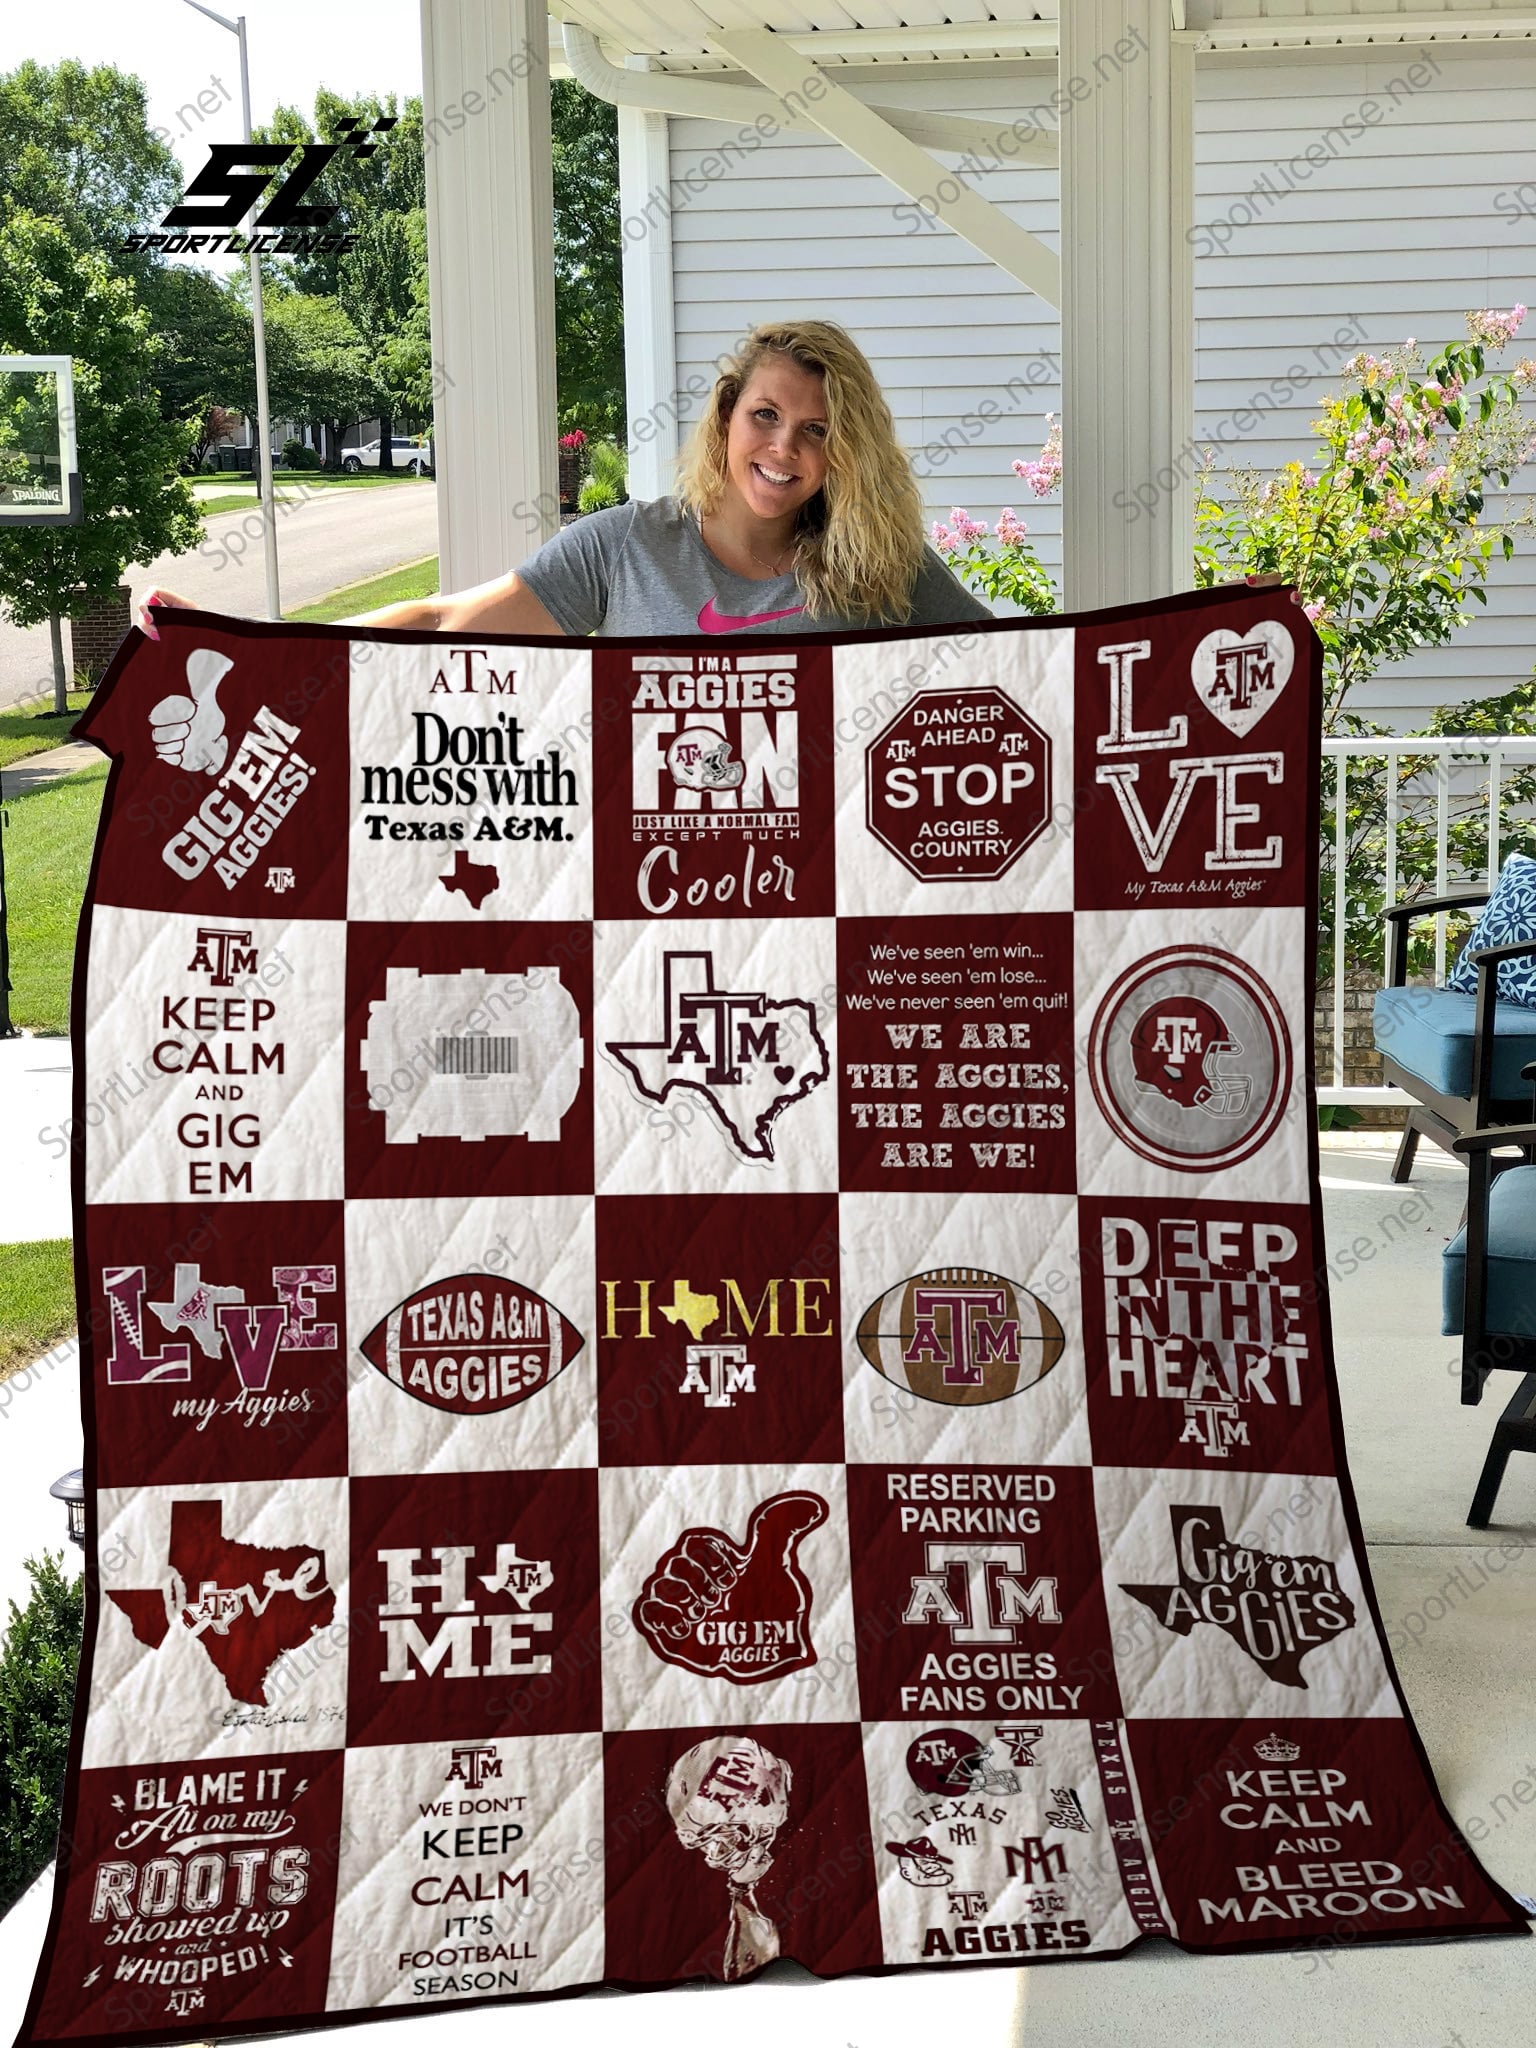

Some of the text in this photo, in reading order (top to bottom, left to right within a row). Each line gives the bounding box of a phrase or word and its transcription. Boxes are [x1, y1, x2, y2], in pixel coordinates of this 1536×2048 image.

[12, 489, 60, 501] SPALDING
[698, 657, 732, 672] I'M A
[632, 672, 796, 709] AGGIES
[913, 705, 1004, 727] DANGER
[411, 711, 525, 768] Don't
[921, 728, 996, 747] AHEAD
[632, 711, 798, 810] FAN
[361, 751, 579, 806] mess with
[884, 761, 1035, 809] STOP
[213, 752, 317, 891] AGGIES!
[364, 815, 574, 842] Texas A&M.
[633, 830, 800, 841] EXCEPT MUCH
[635, 815, 799, 828] JUST LIKE A NORMAL FAN
[910, 839, 1013, 859] COUNTRY
[637, 844, 796, 914] Cooler
[1125, 876, 1263, 900] My Texas A&M Aggies
[870, 943, 1044, 961] We've seen 'em win...
[866, 968, 1047, 985] We've seen 'em lose...
[162, 996, 276, 1032] KEEP
[846, 993, 1069, 1013] We've never seen 'em quit!
[885, 1023, 1031, 1050] WE ARE
[152, 1040, 284, 1075] CALM
[195, 1084, 243, 1101] AND
[846, 1063, 1069, 1094] THE AGGIES,
[176, 1113, 260, 1149] GIG
[850, 1103, 1066, 1129] THE AGGIES
[880, 1142, 1036, 1168] ARE WE!
[189, 1161, 253, 1194] EM
[1101, 1217, 1298, 1280] DEEP
[407, 1291, 542, 1342] TEXAS A&M
[1104, 1278, 1307, 1346] IN THE
[408, 1355, 543, 1402] AGGIES
[1106, 1338, 1309, 1406] HEART
[172, 1387, 315, 1431] my Aggies
[887, 1473, 1056, 1501] RESERVED
[900, 1506, 1041, 1534] PARKING
[1180, 1517, 1262, 1590] Gig
[697, 1619, 799, 1647] GIG EM
[718, 1646, 780, 1664] AGGIES
[920, 1652, 1058, 1681] AGGIES
[901, 1685, 1084, 1711] FANS ONLY
[134, 1768, 287, 1811] BLAME IT
[1225, 1768, 1347, 1798] KEEP
[419, 1796, 526, 1818] WE DON'T
[913, 1801, 1007, 1827] TEXAS
[1219, 1801, 1372, 1830] CALM
[114, 1804, 297, 1851] All on my
[1095, 1721, 1127, 1796] TEXAS
[1123, 1857, 1165, 1928] AGGIES
[422, 1824, 524, 1860] KEEP
[1274, 1837, 1342, 1855] AND
[89, 1846, 311, 1923] ROOTS
[410, 1869, 530, 1906] CALM
[1234, 1861, 1403, 1893] BLEED
[1197, 1885, 1465, 1926] MAROON
[104, 1908, 290, 1947] showed up
[445, 1915, 494, 1939] IT'S
[921, 1920, 1092, 1957] AGGIES
[174, 1939, 212, 1956] and
[398, 1942, 537, 1971] FOOTBALL
[114, 1945, 270, 1985] WHOOPED!
[413, 1970, 519, 1997] SEASON
